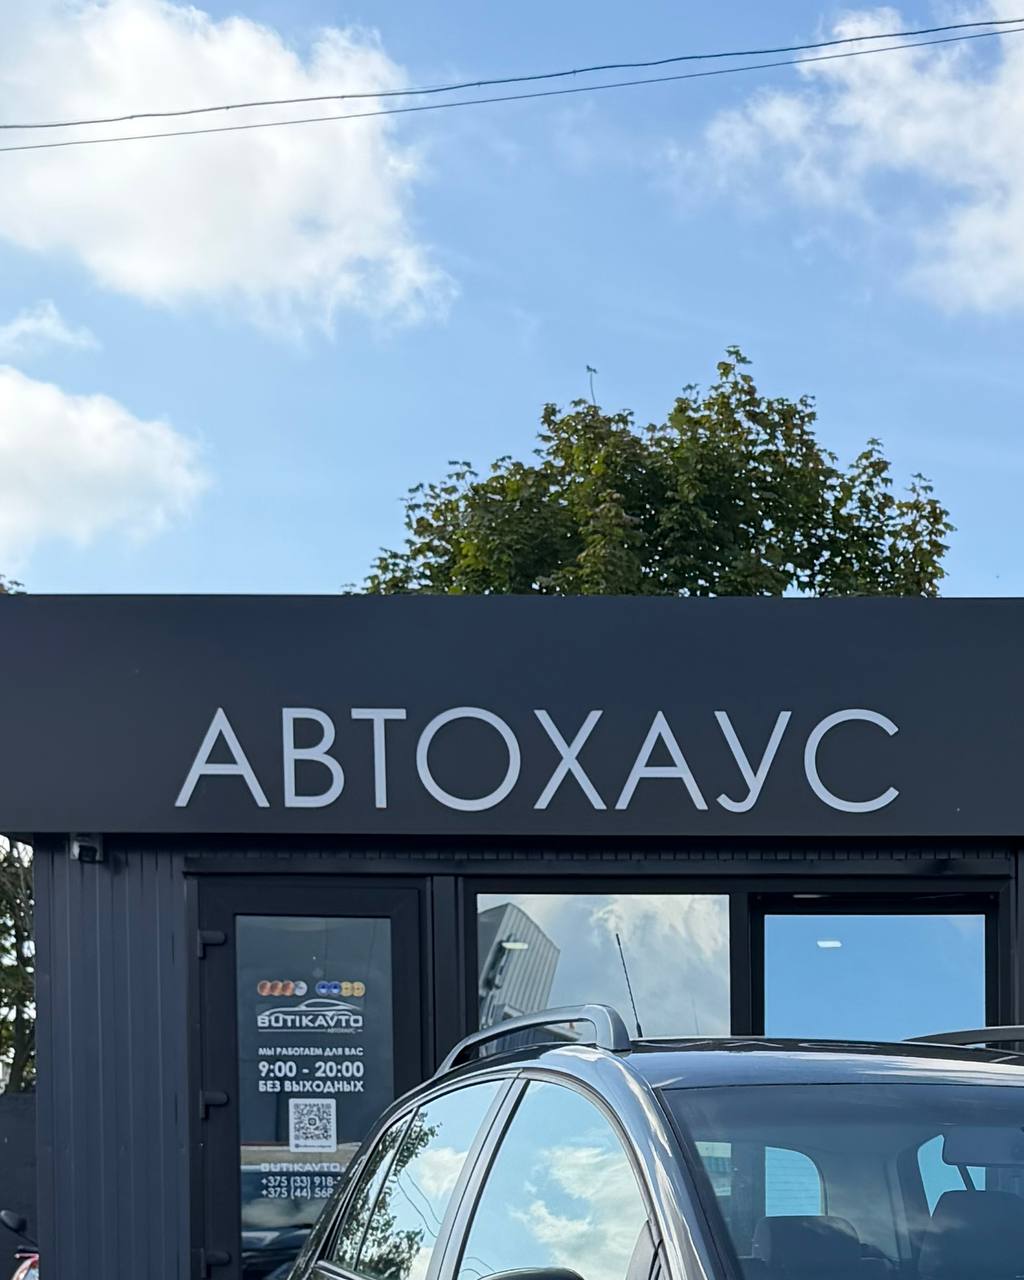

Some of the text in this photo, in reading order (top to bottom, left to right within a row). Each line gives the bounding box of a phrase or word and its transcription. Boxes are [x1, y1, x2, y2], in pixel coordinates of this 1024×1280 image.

[175, 706, 900, 813] АВТОХАУС
[257, 1014, 363, 1027] BUTIKAVTO
[258, 1047, 364, 1056] МЫ РАБОТАЕМ ДЛЯ ВАС
[258, 1061, 297, 1077] 9:00
[315, 1061, 364, 1077] 20:00
[258, 1081, 364, 1093] БЕЗ ВЫХОДНЫХ
[261, 1176, 288, 1186] +375
[290, 1175, 310, 1188] (33)
[261, 1188, 288, 1198] +375
[290, 1187, 310, 1200] (44)
